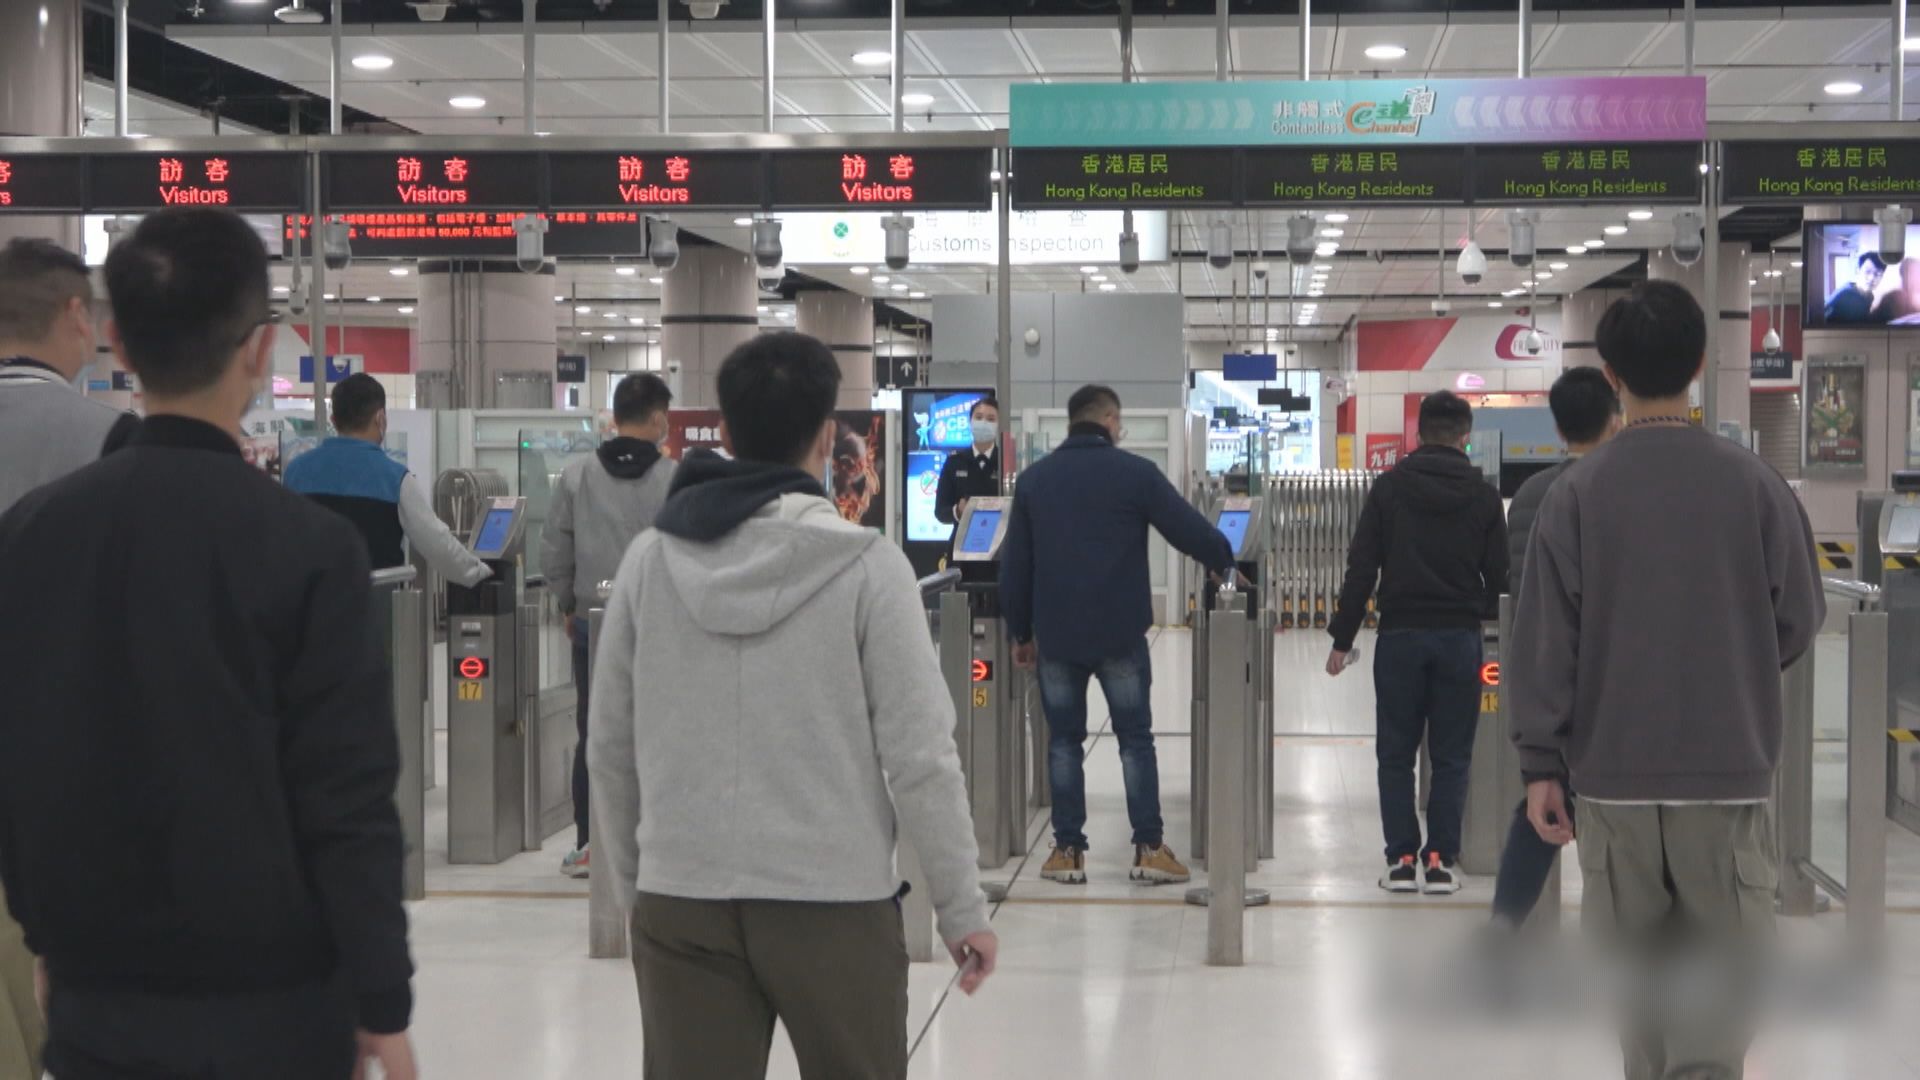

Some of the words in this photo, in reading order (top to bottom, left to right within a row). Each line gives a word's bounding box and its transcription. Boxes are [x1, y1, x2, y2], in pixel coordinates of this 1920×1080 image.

[1271, 119, 1345, 135] Contactless
[1082, 154, 1168, 173] 香港居民
[1311, 153, 1397, 172] 香港居民
[1543, 150, 1631, 170] 香港居民
[1797, 147, 1887, 168] 香港居民
[160, 159, 229, 183] 訪客
[397, 158, 468, 182] 訪客
[619, 157, 691, 182] 訪客
[842, 155, 914, 181] 訪客
[160, 185, 229, 204] Visitors
[397, 184, 468, 204] Visitors
[618, 183, 690, 203] Visitors
[841, 182, 913, 202] Visitors
[1045, 183, 1085, 201] Hong
[1089, 183, 1127, 201] Kong
[1132, 183, 1203, 199] Residents
[1274, 181, 1313, 199] Hong
[1318, 181, 1356, 199] Kong
[1361, 181, 1433, 197] Residents
[1504, 179, 1546, 198] Hong
[1550, 179, 1588, 198] Kong
[1593, 179, 1666, 195] Residents
[1759, 177, 1800, 195] Hong
[1804, 177, 1844, 195] Kong
[1848, 176, 1920, 192] Residents
[908, 233, 992, 252] Customs
[1008, 233, 1105, 255] nspection
[946, 415, 969, 431] CB
[462, 681, 480, 700] 17
